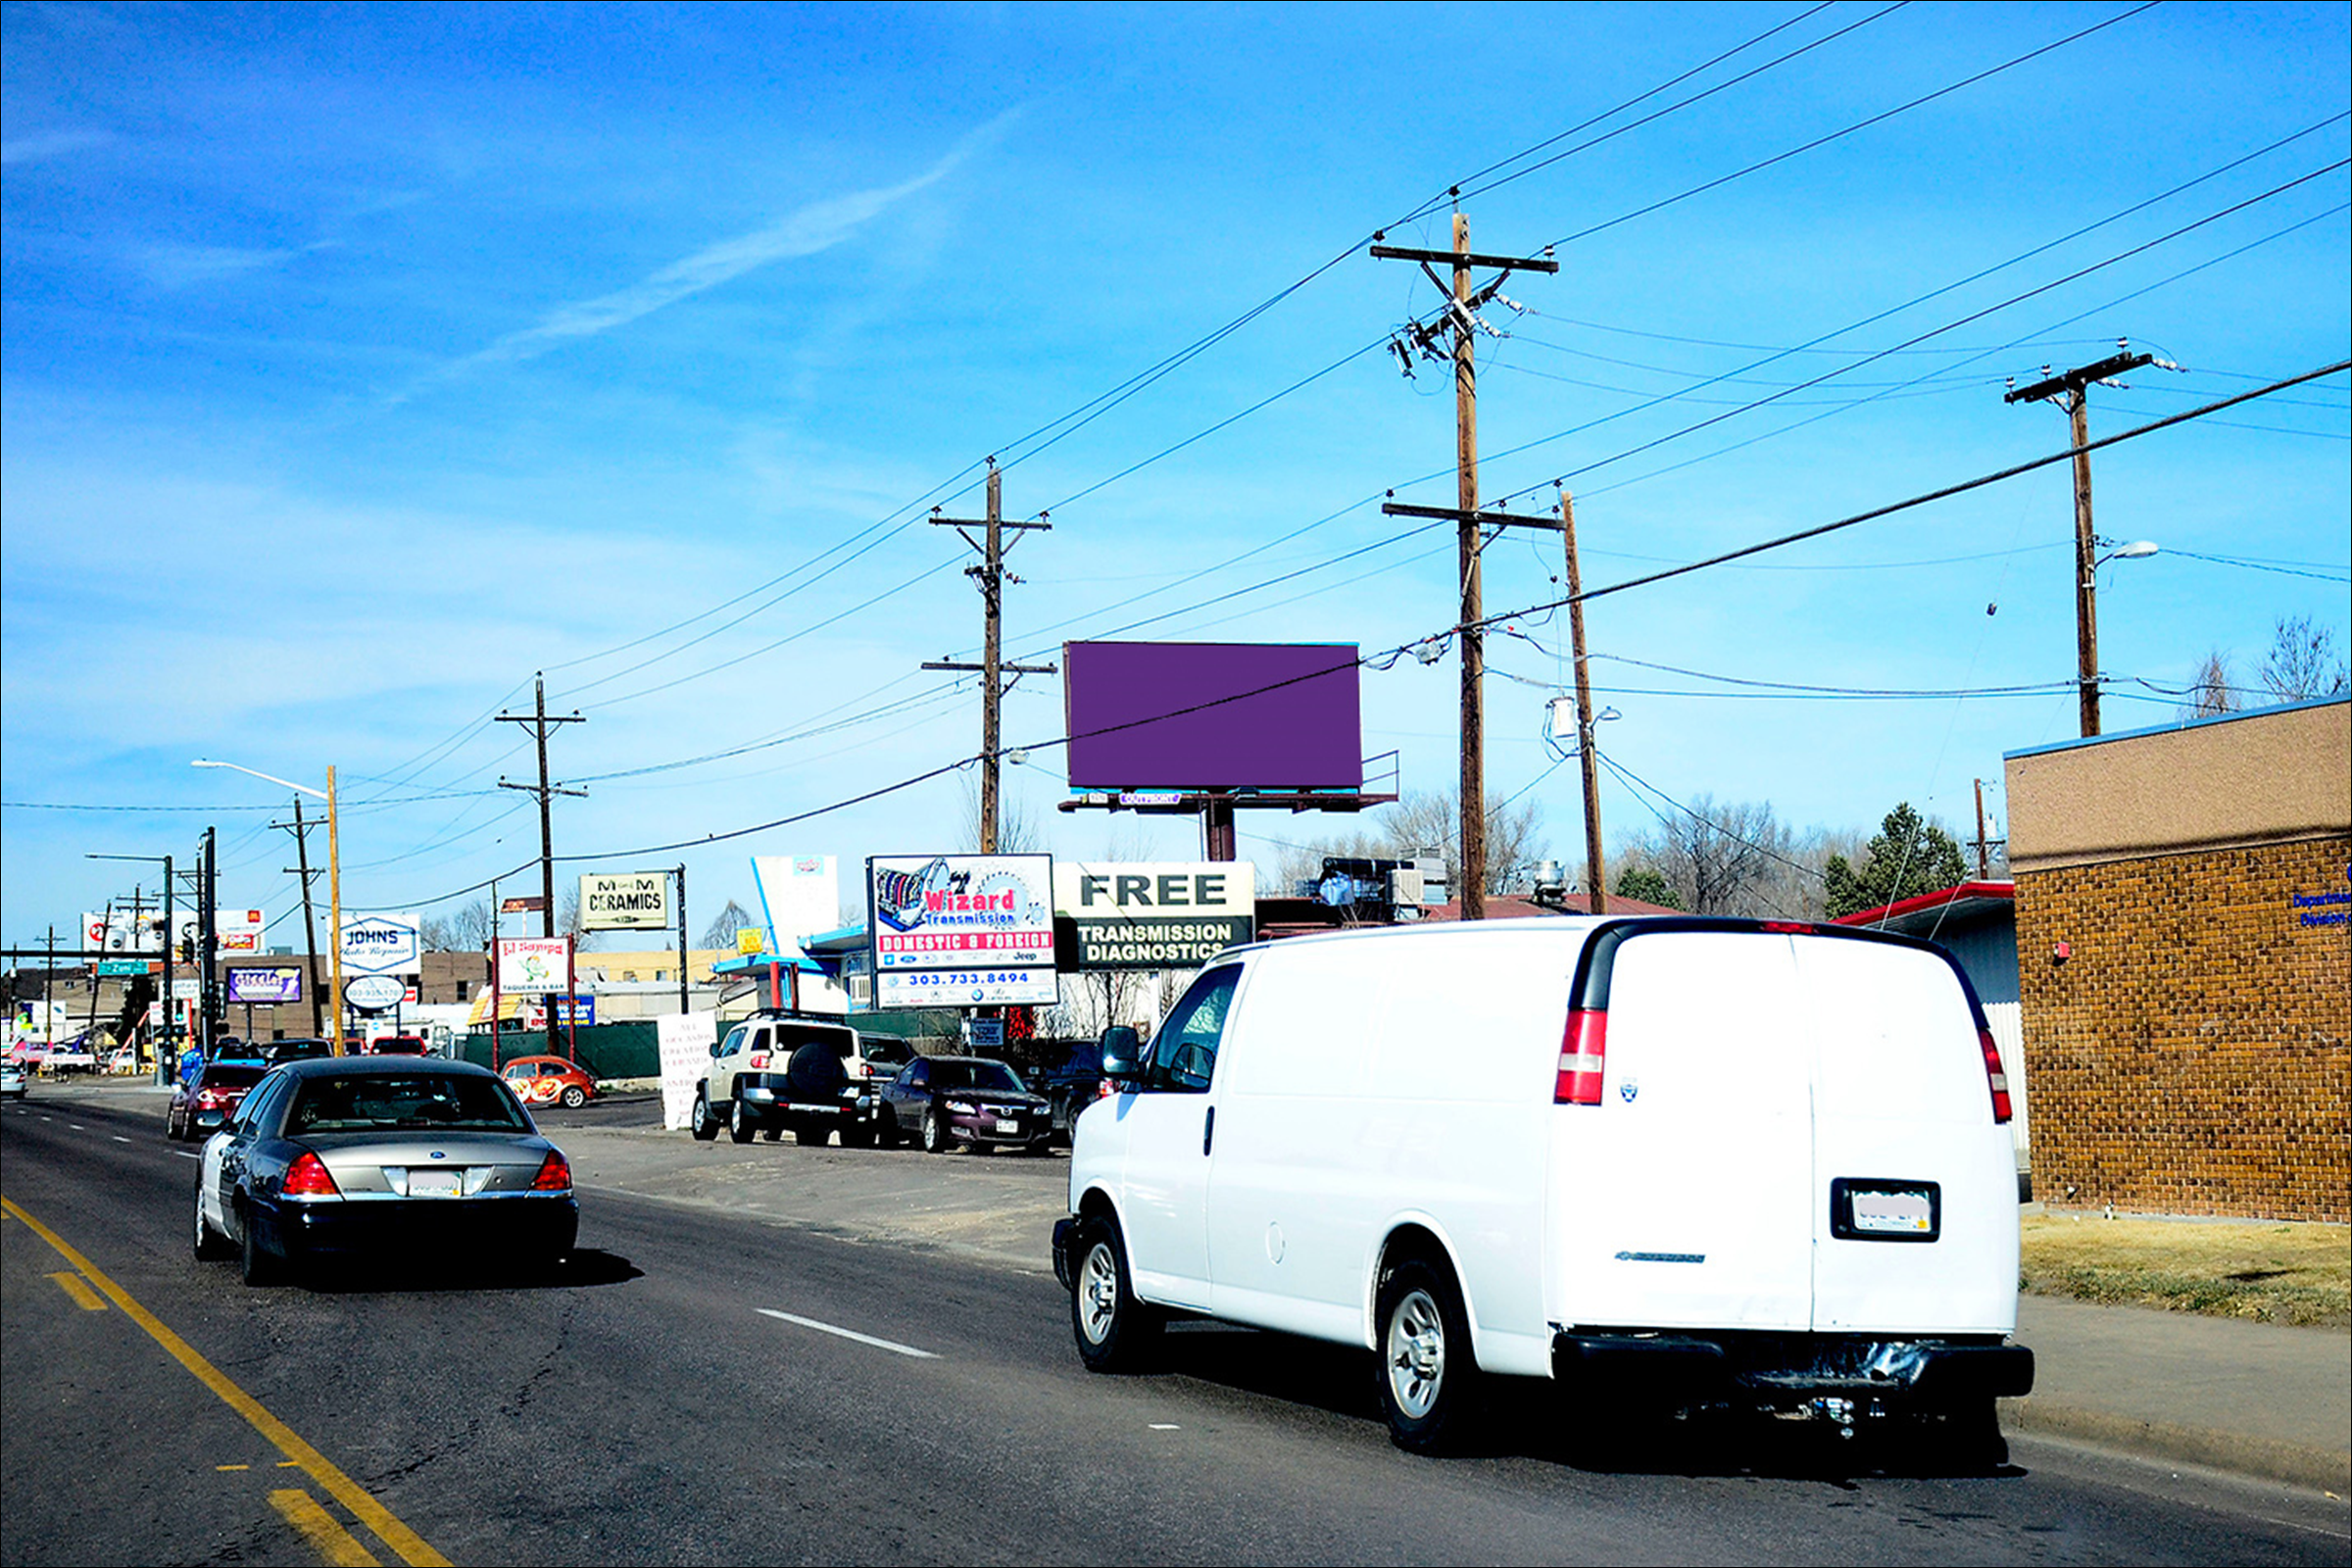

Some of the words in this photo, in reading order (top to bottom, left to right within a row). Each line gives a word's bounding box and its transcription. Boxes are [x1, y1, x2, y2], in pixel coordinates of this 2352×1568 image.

[598, 880, 616, 892] M
[636, 879, 655, 891] M
[1081, 874, 1227, 906] FREE
[590, 893, 662, 911] CERAMICS
[924, 889, 1014, 911] Wizard
[924, 912, 1014, 925] Transmission
[2300, 910, 2346, 926] Division
[346, 930, 398, 946] JOHNS
[883, 934, 961, 951] DOMESTIC
[968, 935, 978, 948] &
[986, 933, 1050, 949] FOREIGN
[1077, 924, 1232, 943] TRANSMISSION
[1087, 943, 1224, 961] DIAGNOSTICS
[909, 972, 1029, 986] 303.733.8494
